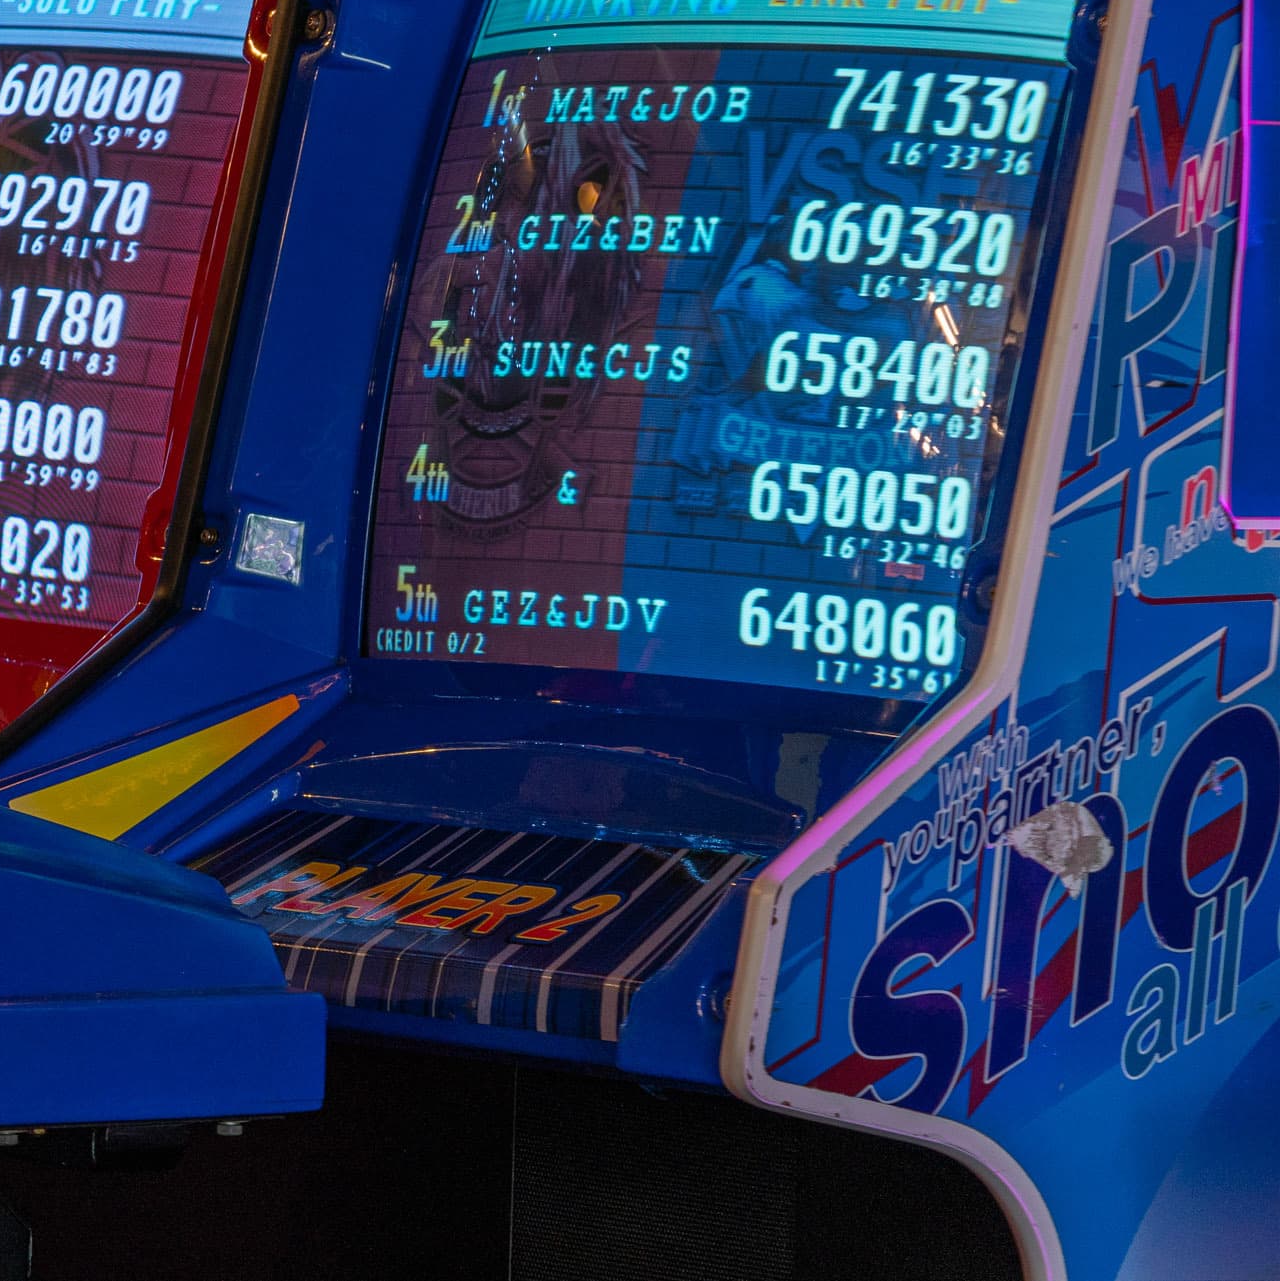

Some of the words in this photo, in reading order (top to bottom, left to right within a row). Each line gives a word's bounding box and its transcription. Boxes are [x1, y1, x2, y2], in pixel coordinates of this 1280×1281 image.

[482, 69, 527, 128] 1st
[544, 85, 753, 124] MAT&JOB
[827, 67, 1050, 143] 741330
[446, 195, 498, 255] 2nd
[517, 214, 722, 255] GIZ&BEN
[788, 199, 1016, 277] 669320
[422, 318, 469, 379] 3rd
[492, 341, 693, 382] SUN&CJS
[764, 329, 992, 410] 658400
[403, 442, 451, 506] 4th
[748, 460, 972, 540] 650050
[376, 627, 435, 655] CREDIT
[395, 563, 438, 625] 5th
[462, 589, 668, 634] GEZ&JDV
[738, 586, 957, 667] 648060
[232, 860, 558, 936] PLAYER
[516, 892, 623, 944] 2
